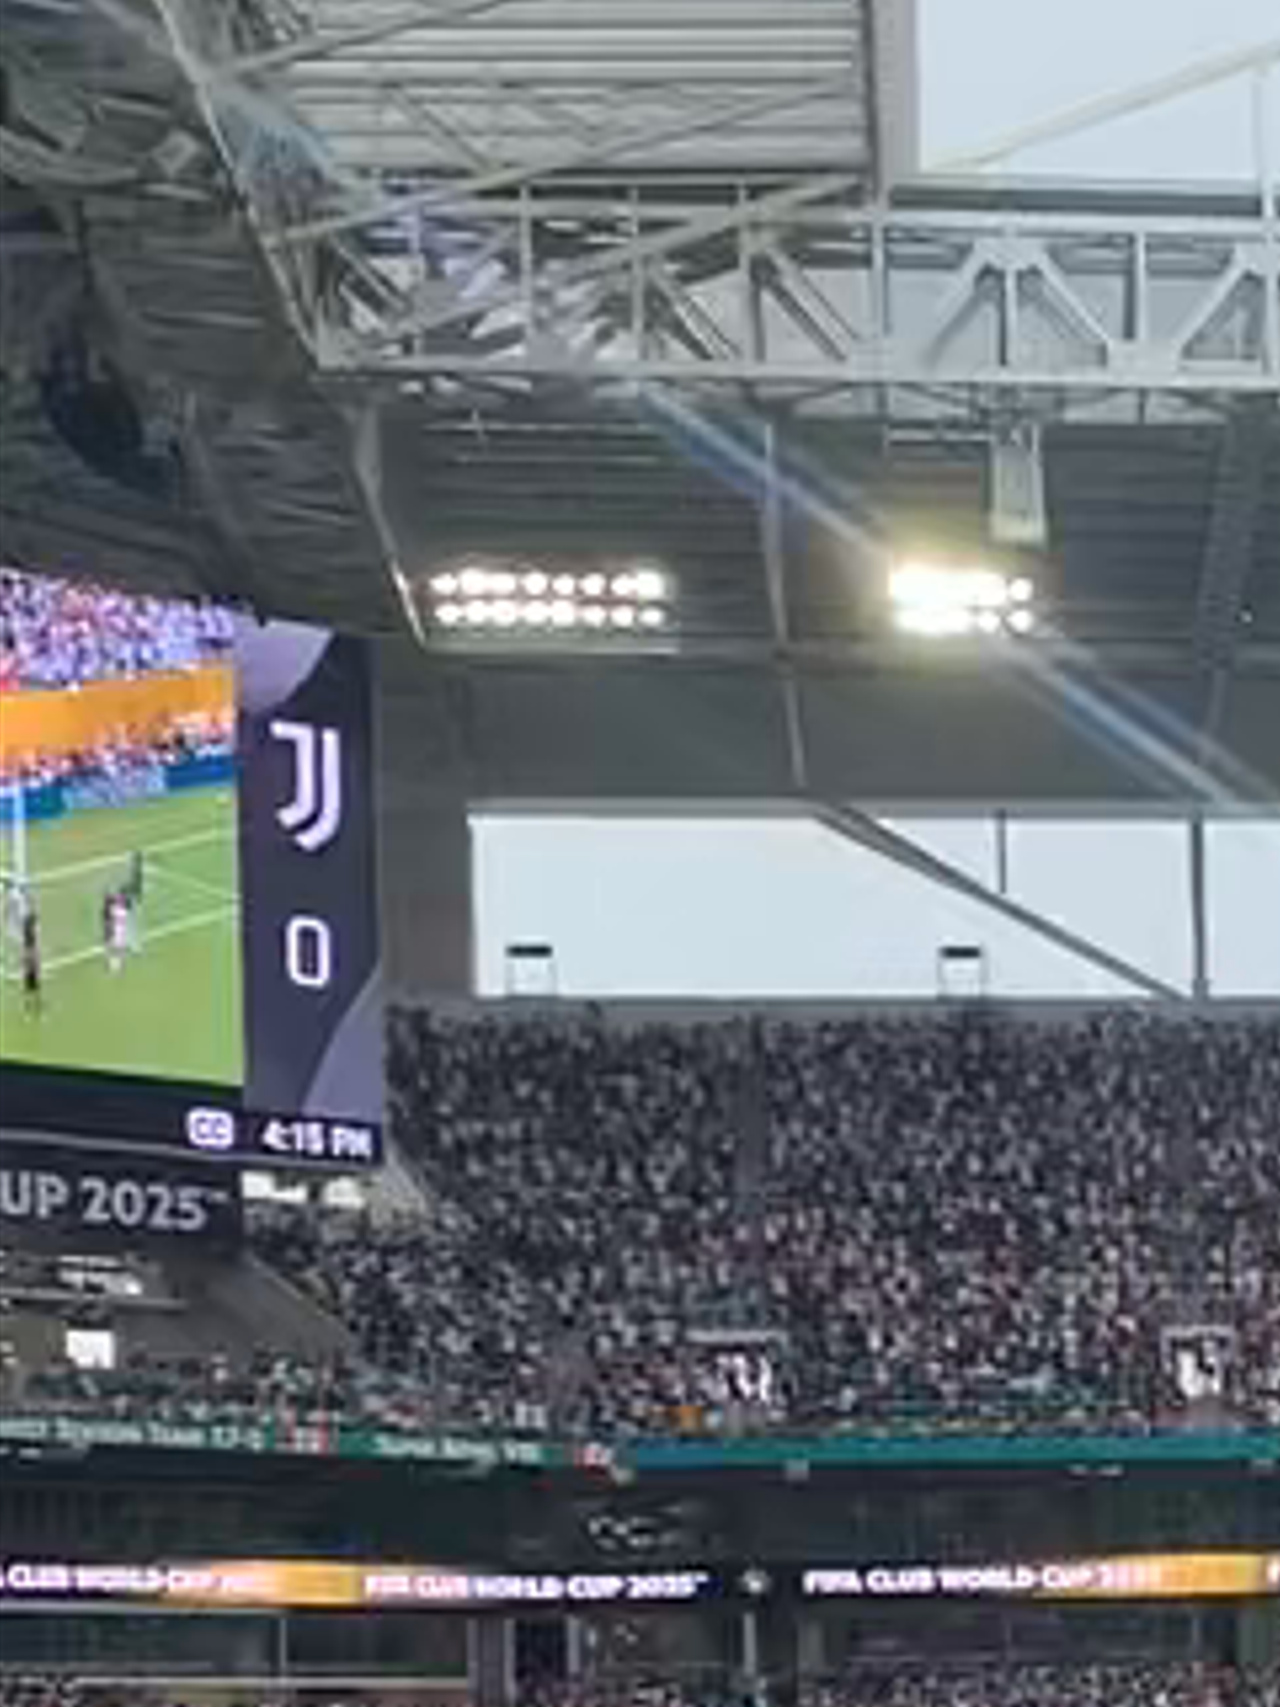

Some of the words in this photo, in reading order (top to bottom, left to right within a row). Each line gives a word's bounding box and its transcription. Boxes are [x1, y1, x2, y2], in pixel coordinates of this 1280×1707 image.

[286, 916, 330, 987] 0
[331, 1126, 372, 1158] PM
[1, 1170, 69, 1219] UP
